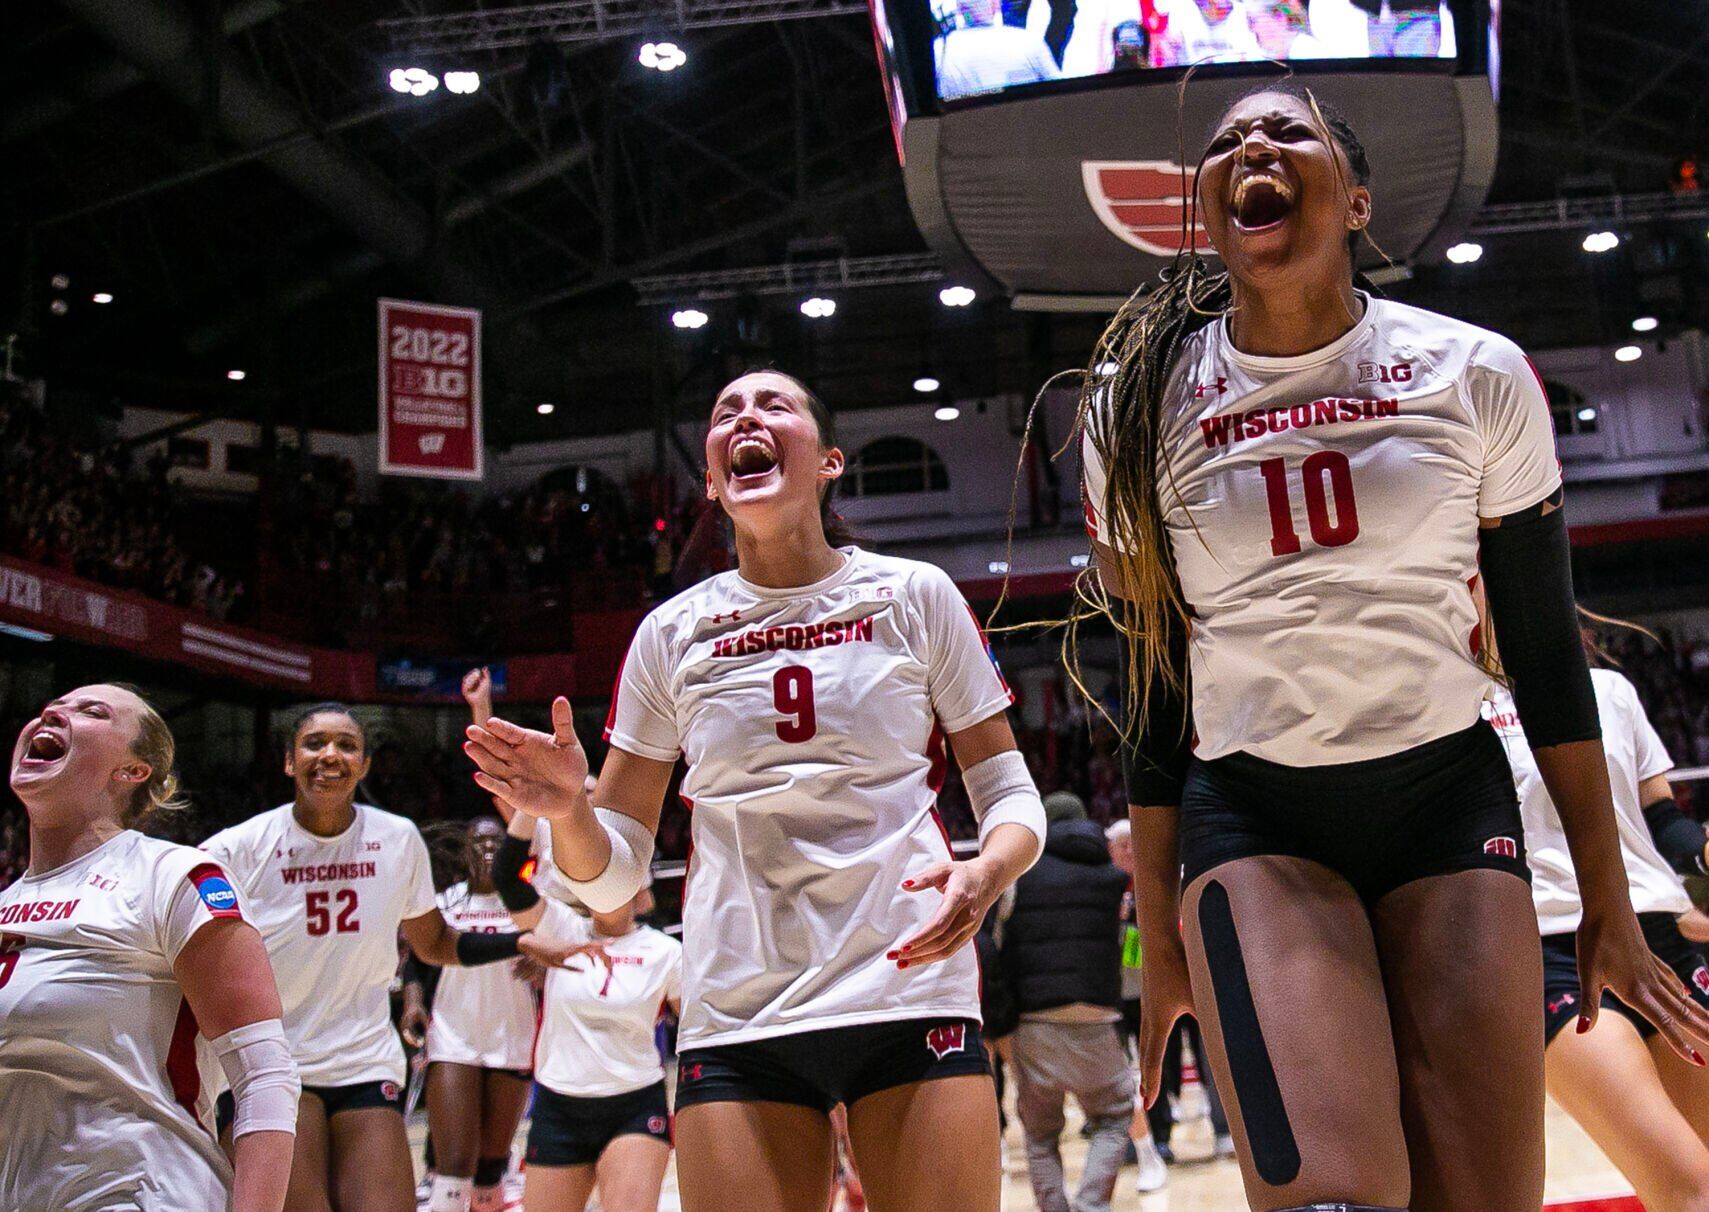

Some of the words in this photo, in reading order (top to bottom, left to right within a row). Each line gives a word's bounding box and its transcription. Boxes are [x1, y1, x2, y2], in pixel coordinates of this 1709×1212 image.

[391, 325, 469, 367] 2022
[1200, 398, 1400, 449] WISCONSIN
[1260, 450, 1360, 557] 10
[712, 617, 874, 658] WISCONSIN
[773, 665, 817, 744] 9
[281, 861, 376, 885] WISCONSIN
[305, 888, 360, 937] 52
